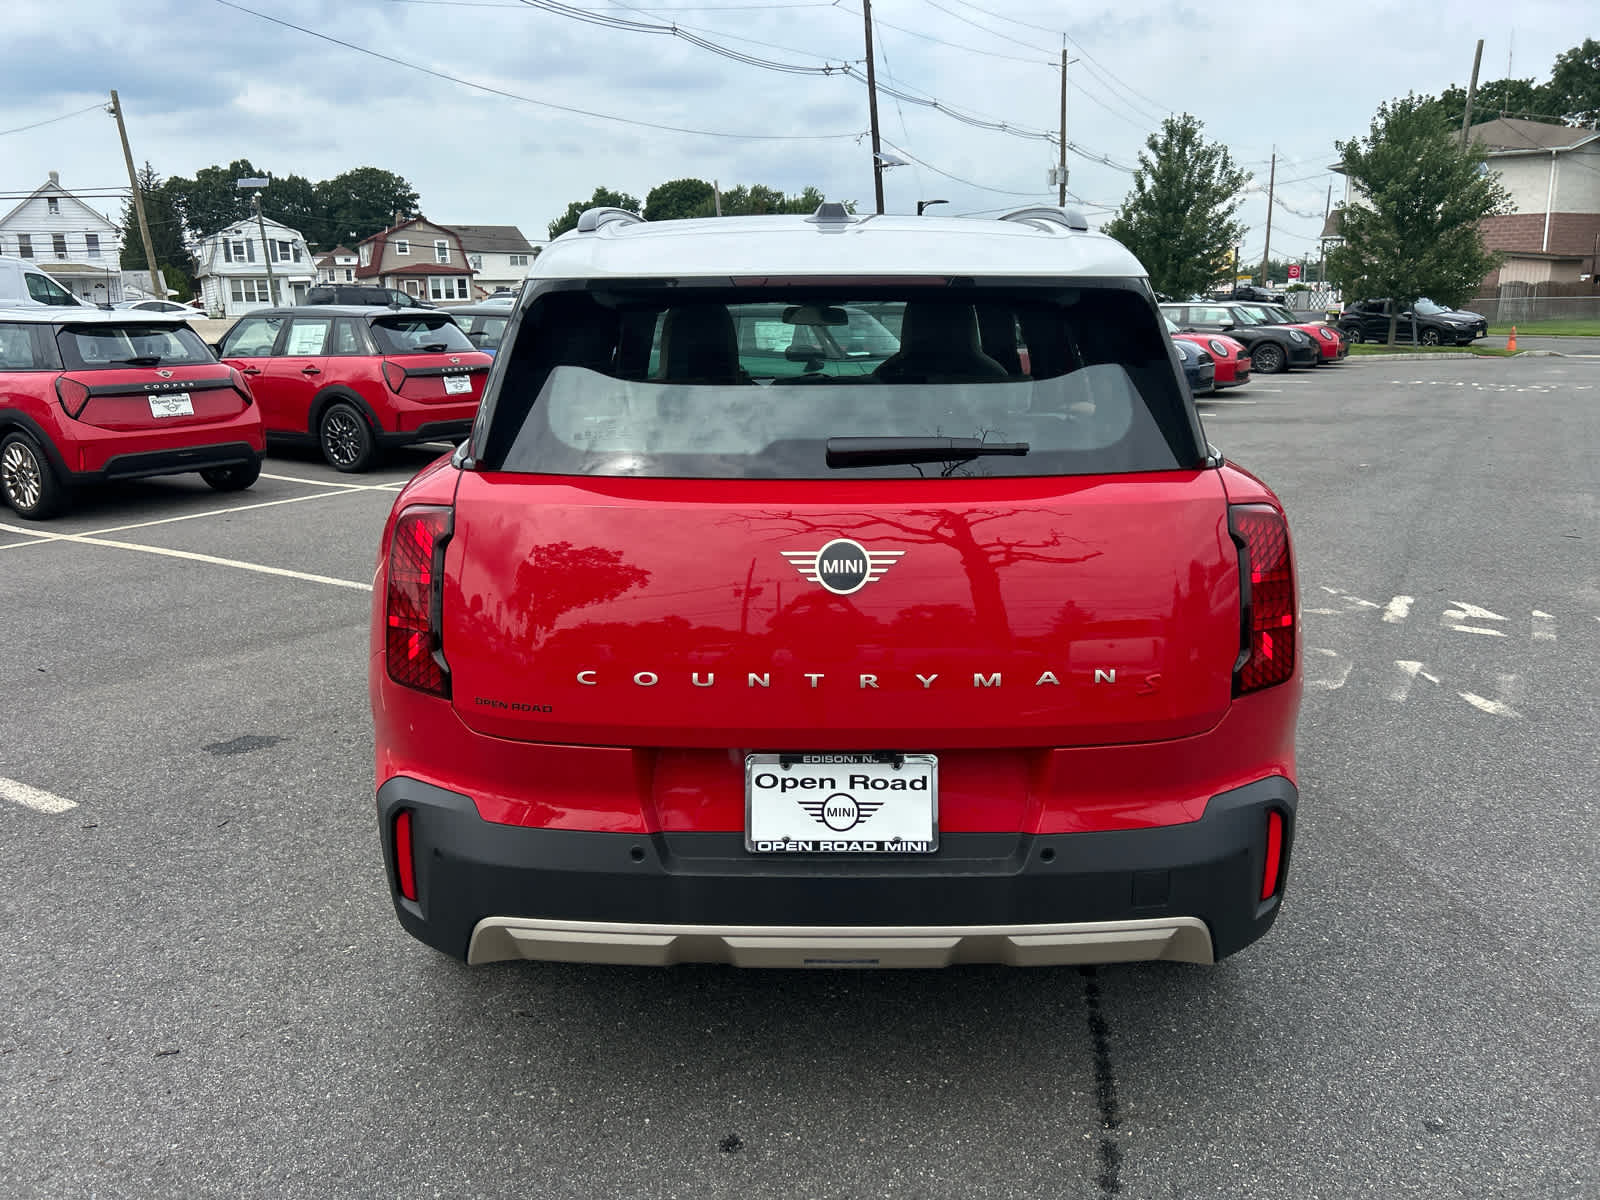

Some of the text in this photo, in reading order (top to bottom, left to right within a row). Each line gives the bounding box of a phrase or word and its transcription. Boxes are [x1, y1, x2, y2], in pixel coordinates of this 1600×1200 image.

[144, 382, 194, 390] COOPER
[823, 559, 863, 574] MINI
[576, 669, 1161, 696] COUNTRYMAN S
[475, 697, 553, 713] OPEN ROAD
[755, 773, 928, 792] Open Road
[827, 807, 855, 818] MINI
[757, 841, 928, 851] OPEN ROAD MINI
